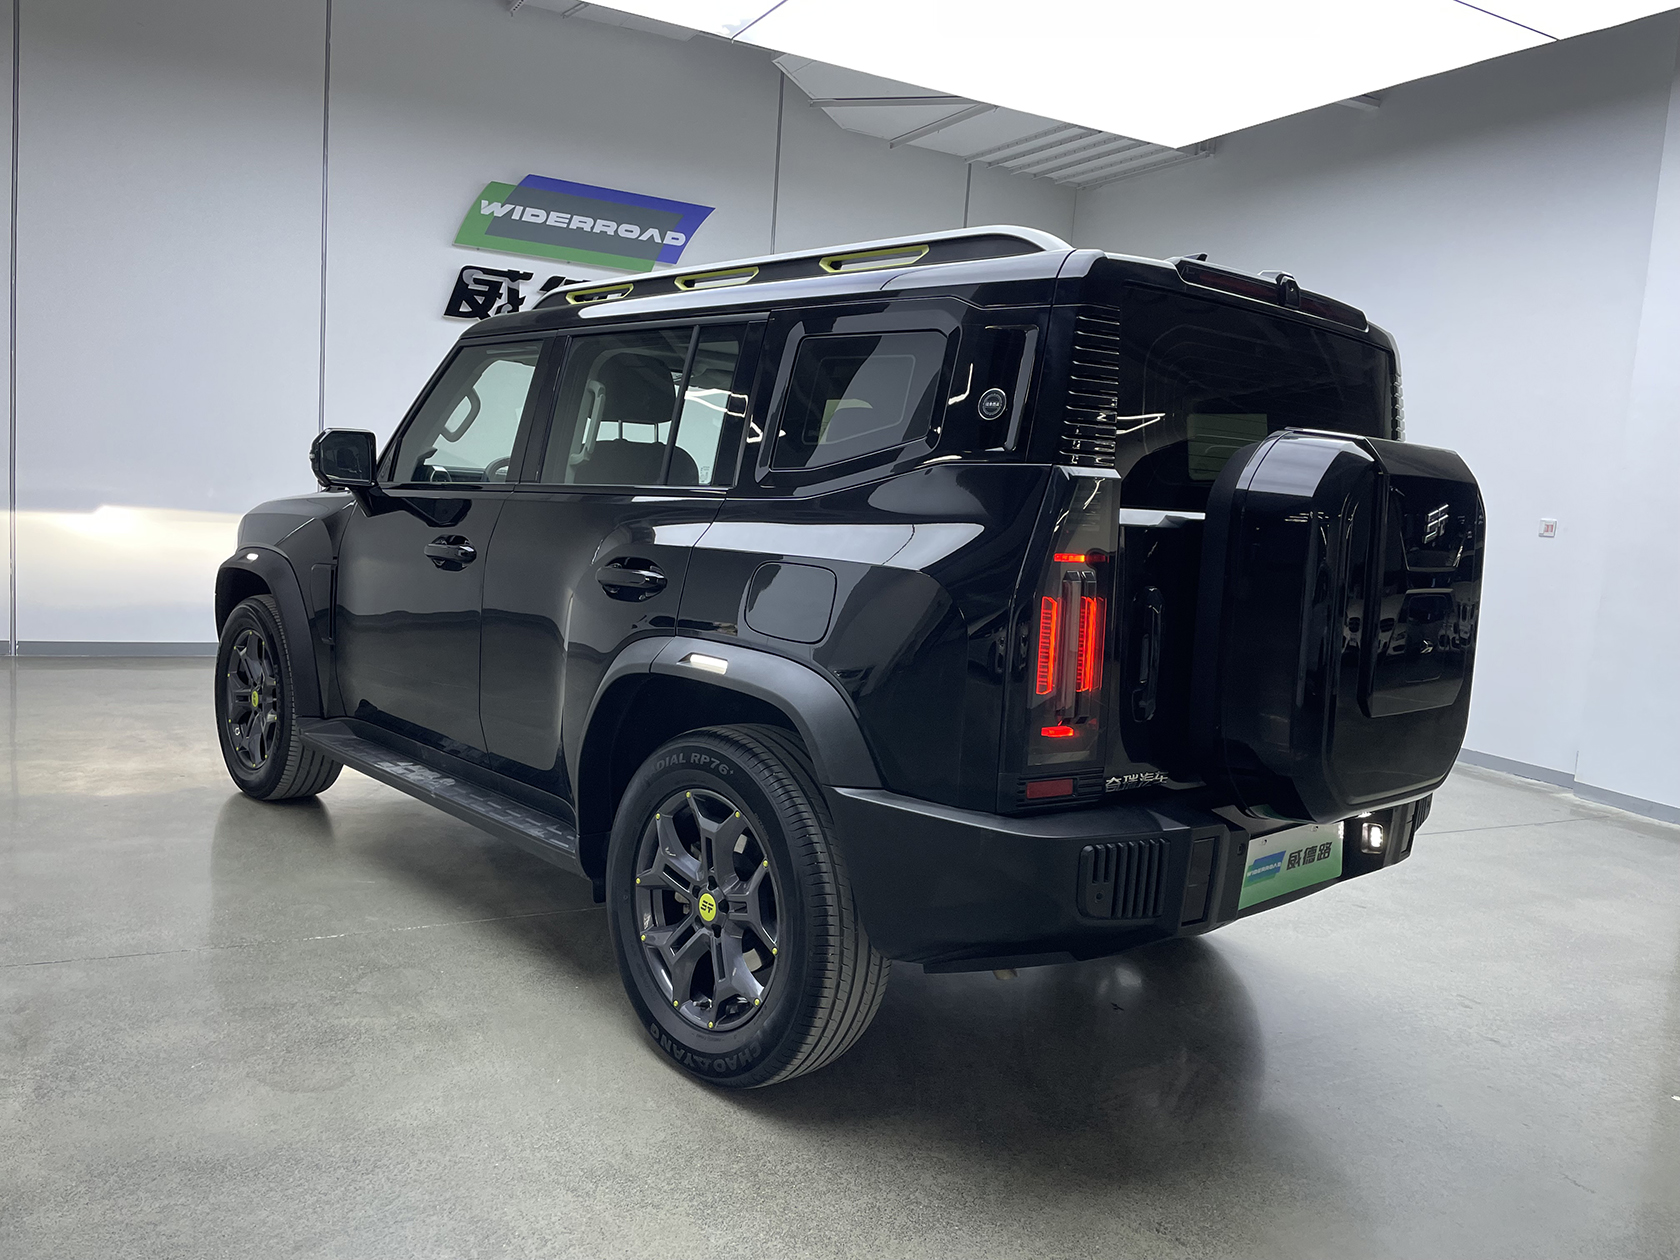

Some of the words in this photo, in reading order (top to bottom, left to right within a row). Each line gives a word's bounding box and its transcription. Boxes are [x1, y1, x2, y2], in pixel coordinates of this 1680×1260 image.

[480, 200, 687, 247] WIDERROAD
[1105, 770, 1169, 793] 奇瑞汽车
[1286, 841, 1333, 871] 威德路
